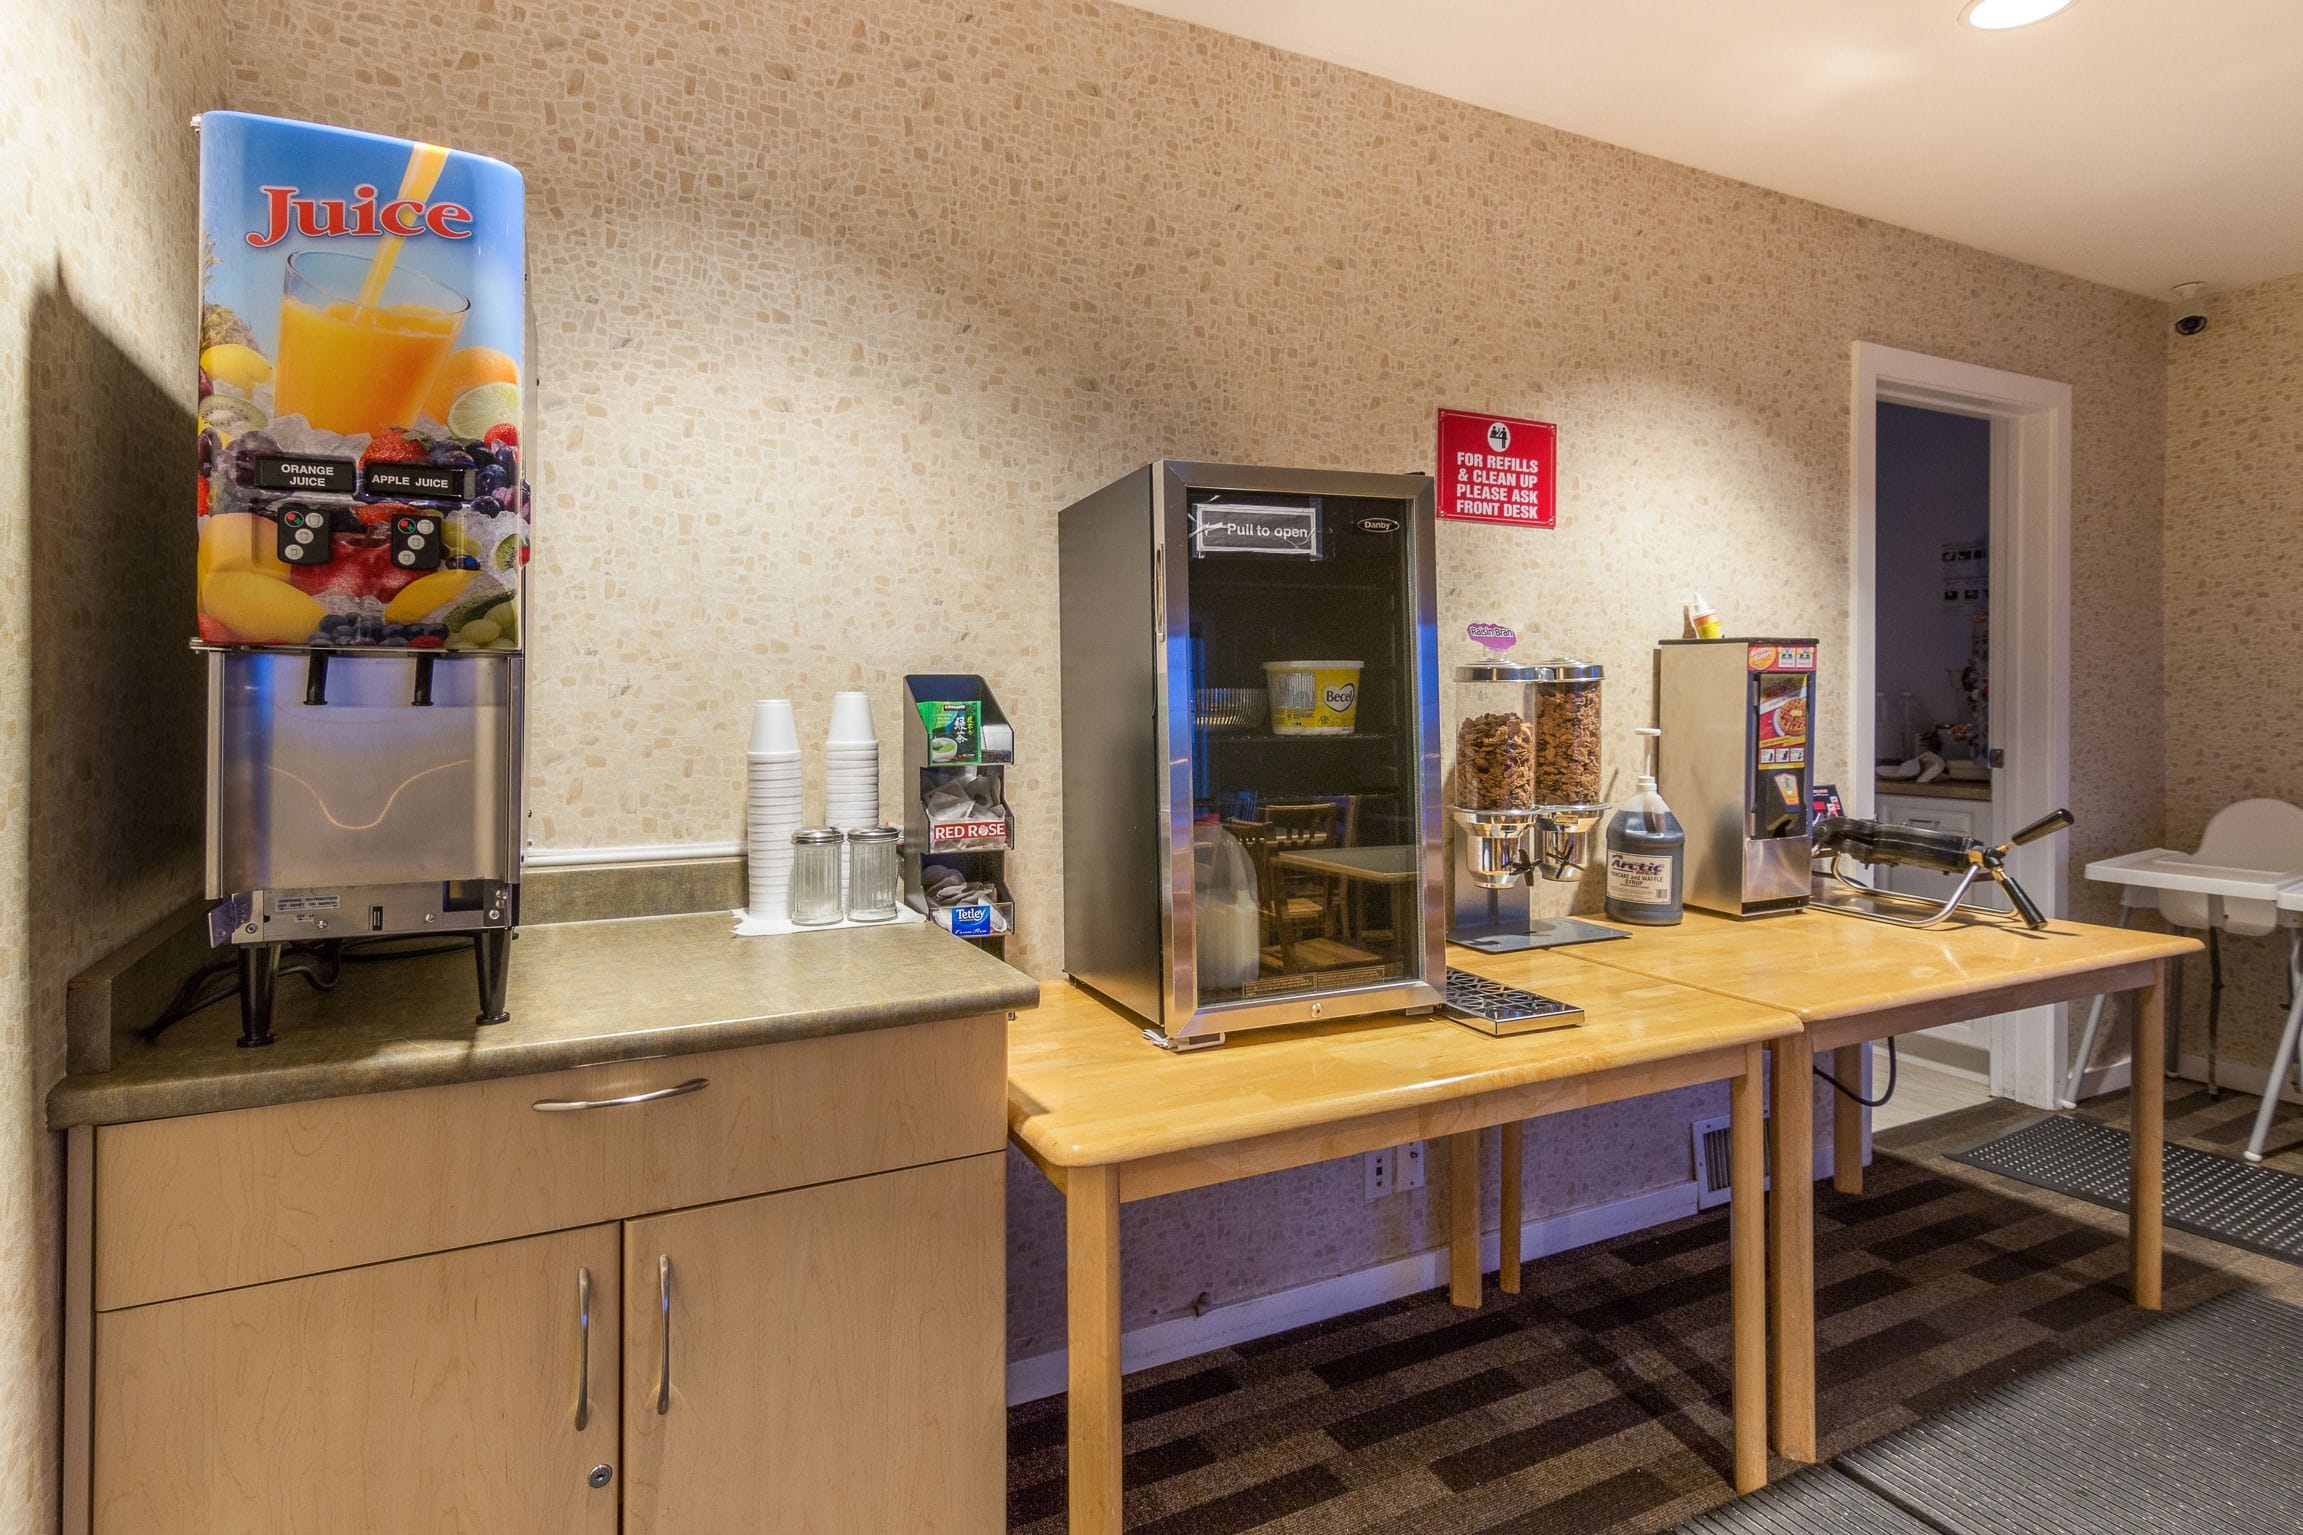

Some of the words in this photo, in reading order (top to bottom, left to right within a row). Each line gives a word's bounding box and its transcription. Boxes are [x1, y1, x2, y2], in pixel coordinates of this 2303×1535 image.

[246, 184, 473, 247] Juice
[281, 464, 334, 476] ORANGE
[1457, 452, 1483, 467] FOR
[1487, 455, 1539, 473] REFILLS
[289, 476, 326, 488] JUICE
[371, 474, 410, 486] APPLE
[415, 476, 449, 489] JUICE
[1458, 468, 1468, 481] &
[1473, 469, 1517, 487] CLEAN
[1520, 476, 1538, 488] UP
[1456, 484, 1508, 501] PLEASE
[1511, 490, 1538, 504] ASK
[1456, 500, 1501, 516] FRONT
[1503, 505, 1538, 519] DESK
[1227, 523, 1254, 536] Pull
[1257, 525, 1270, 537] to
[1274, 527, 1308, 540] open
[1364, 521, 1392, 531] Danby
[1471, 626, 1493, 637] Raisin
[1494, 627, 1514, 637] Bran
[1326, 690, 1353, 702] Becel
[935, 825, 965, 839] RED
[968, 823, 1006, 837] ROSE
[1611, 859, 1664, 875] Arctic
[956, 908, 986, 921] Tetley
